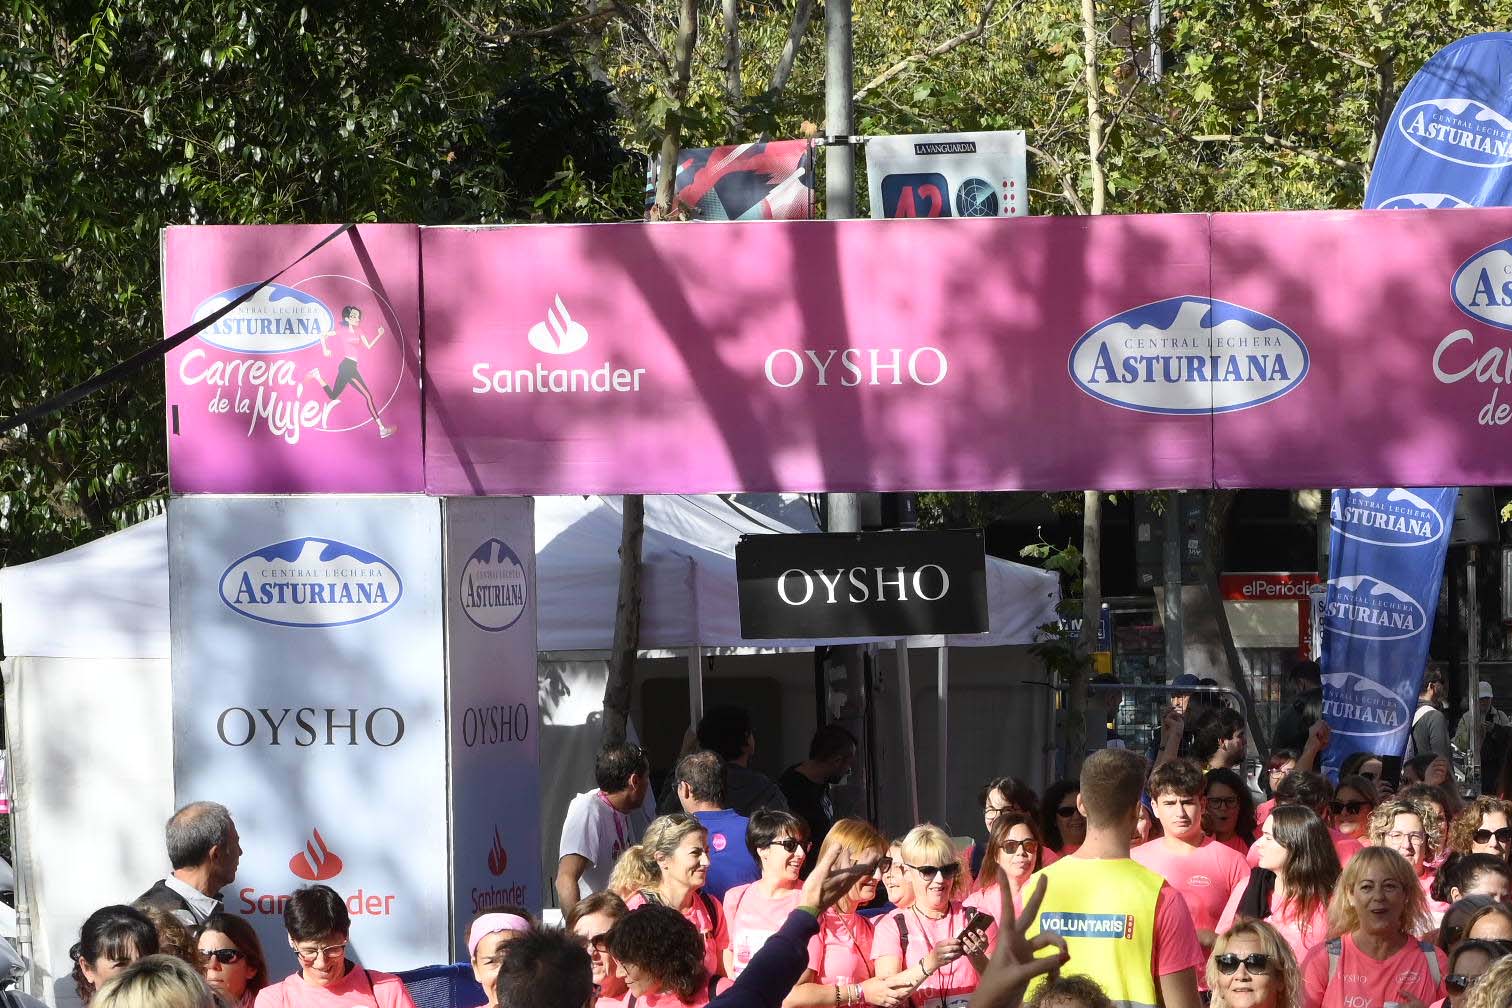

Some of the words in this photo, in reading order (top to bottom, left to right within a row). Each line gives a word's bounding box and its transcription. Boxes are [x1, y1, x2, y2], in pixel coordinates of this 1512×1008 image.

[1432, 113, 1473, 129] CENTRAL
[916, 145, 928, 154] LA
[926, 142, 975, 153] VANGUARDIA
[1124, 337, 1199, 348] CENTRAL
[1206, 336, 1282, 347] LECHERA
[179, 349, 297, 386] Carrera
[472, 361, 646, 394] Santander
[764, 346, 949, 389] OYSHO
[1087, 341, 1291, 385] ASTURIANA
[208, 387, 229, 413] de
[234, 386, 251, 413] la
[248, 383, 342, 445] Mujer
[1478, 387, 1512, 426] de
[1330, 496, 1432, 538] ASTURIANA
[1352, 499, 1386, 510] ENTRAL
[234, 571, 389, 604] ASTURIANA
[261, 569, 321, 578] CENTRAL
[325, 569, 383, 578] LECHERA
[777, 563, 950, 606] OYSHO
[1242, 579, 1316, 598] elPeriódi
[466, 572, 523, 608] ASTURIANA
[1337, 593, 1369, 605] ENTRAL
[1326, 602, 1415, 630] STURIANA
[217, 707, 405, 747] OYSHO
[462, 702, 529, 748] OYSHO
[1322, 699, 1400, 727] TURIANA
[239, 887, 395, 916] Sander
[1042, 918, 1123, 933] VOLUNTARIS
[1344, 996, 1372, 1008] HOY
